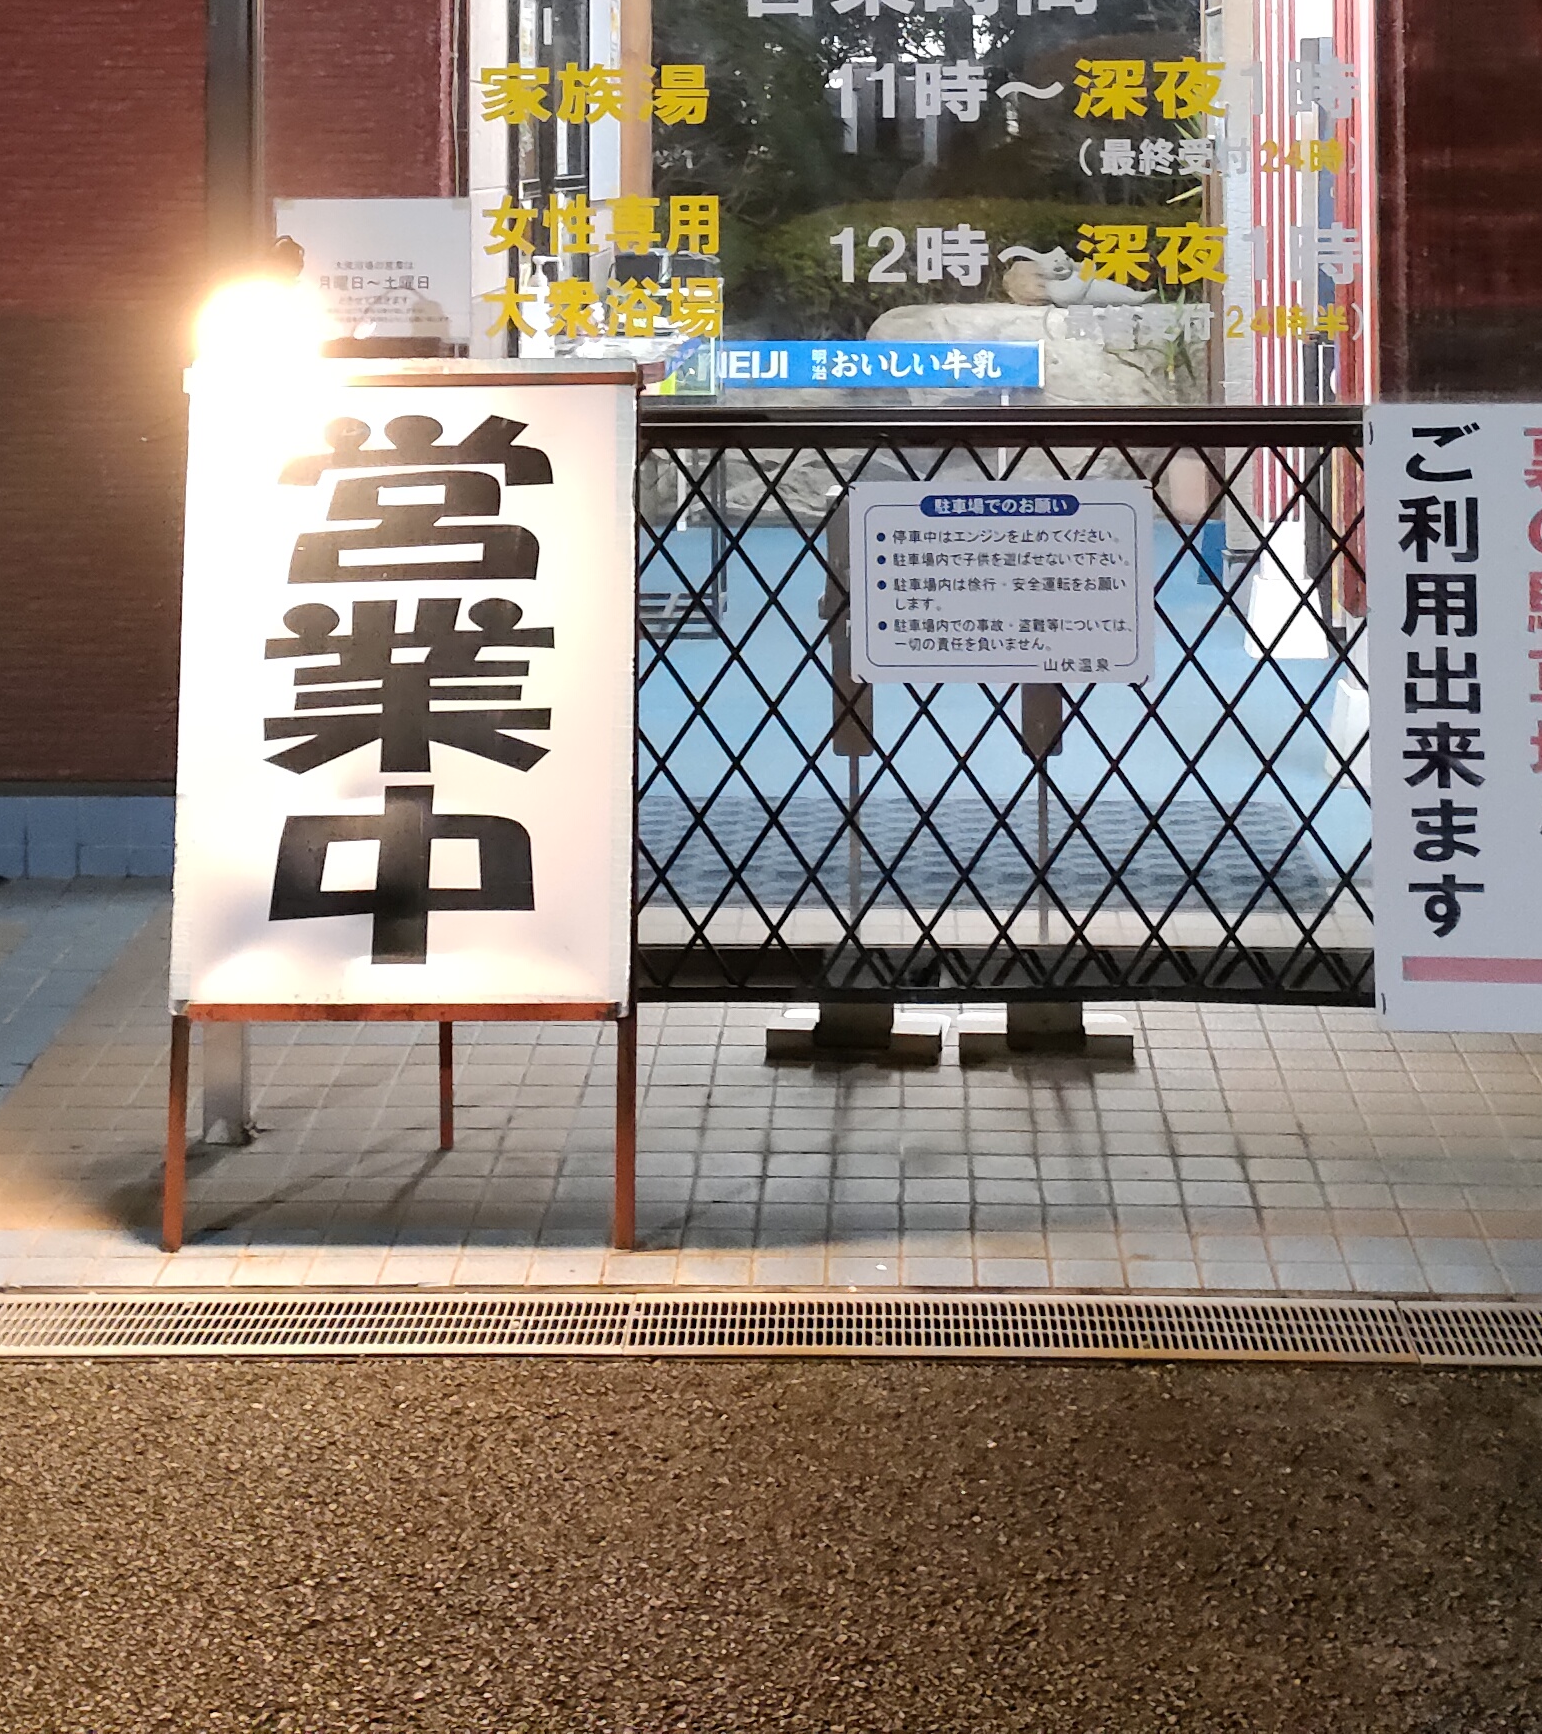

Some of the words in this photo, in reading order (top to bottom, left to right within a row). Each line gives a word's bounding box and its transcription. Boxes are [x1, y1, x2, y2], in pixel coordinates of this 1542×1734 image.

[481, 62, 711, 126] 家族湯
[482, 193, 722, 257] 女性専用
[482, 277, 724, 340] 大衆浴場
[1042, 302, 1364, 342] （最付24時半）
[811, 349, 827, 381] 明治
[831, 349, 1002, 380] おいしい牛乳
[933, 496, 1068, 515] 駐車場でのお願い
[891, 529, 1121, 545] 停車中はエンジンを止めてください。
[895, 596, 943, 613] します。
[1042, 657, 1112, 673] 山伏温泉
[1397, 421, 1486, 938] ご利用出来ます
[262, 413, 556, 965] 営業中
